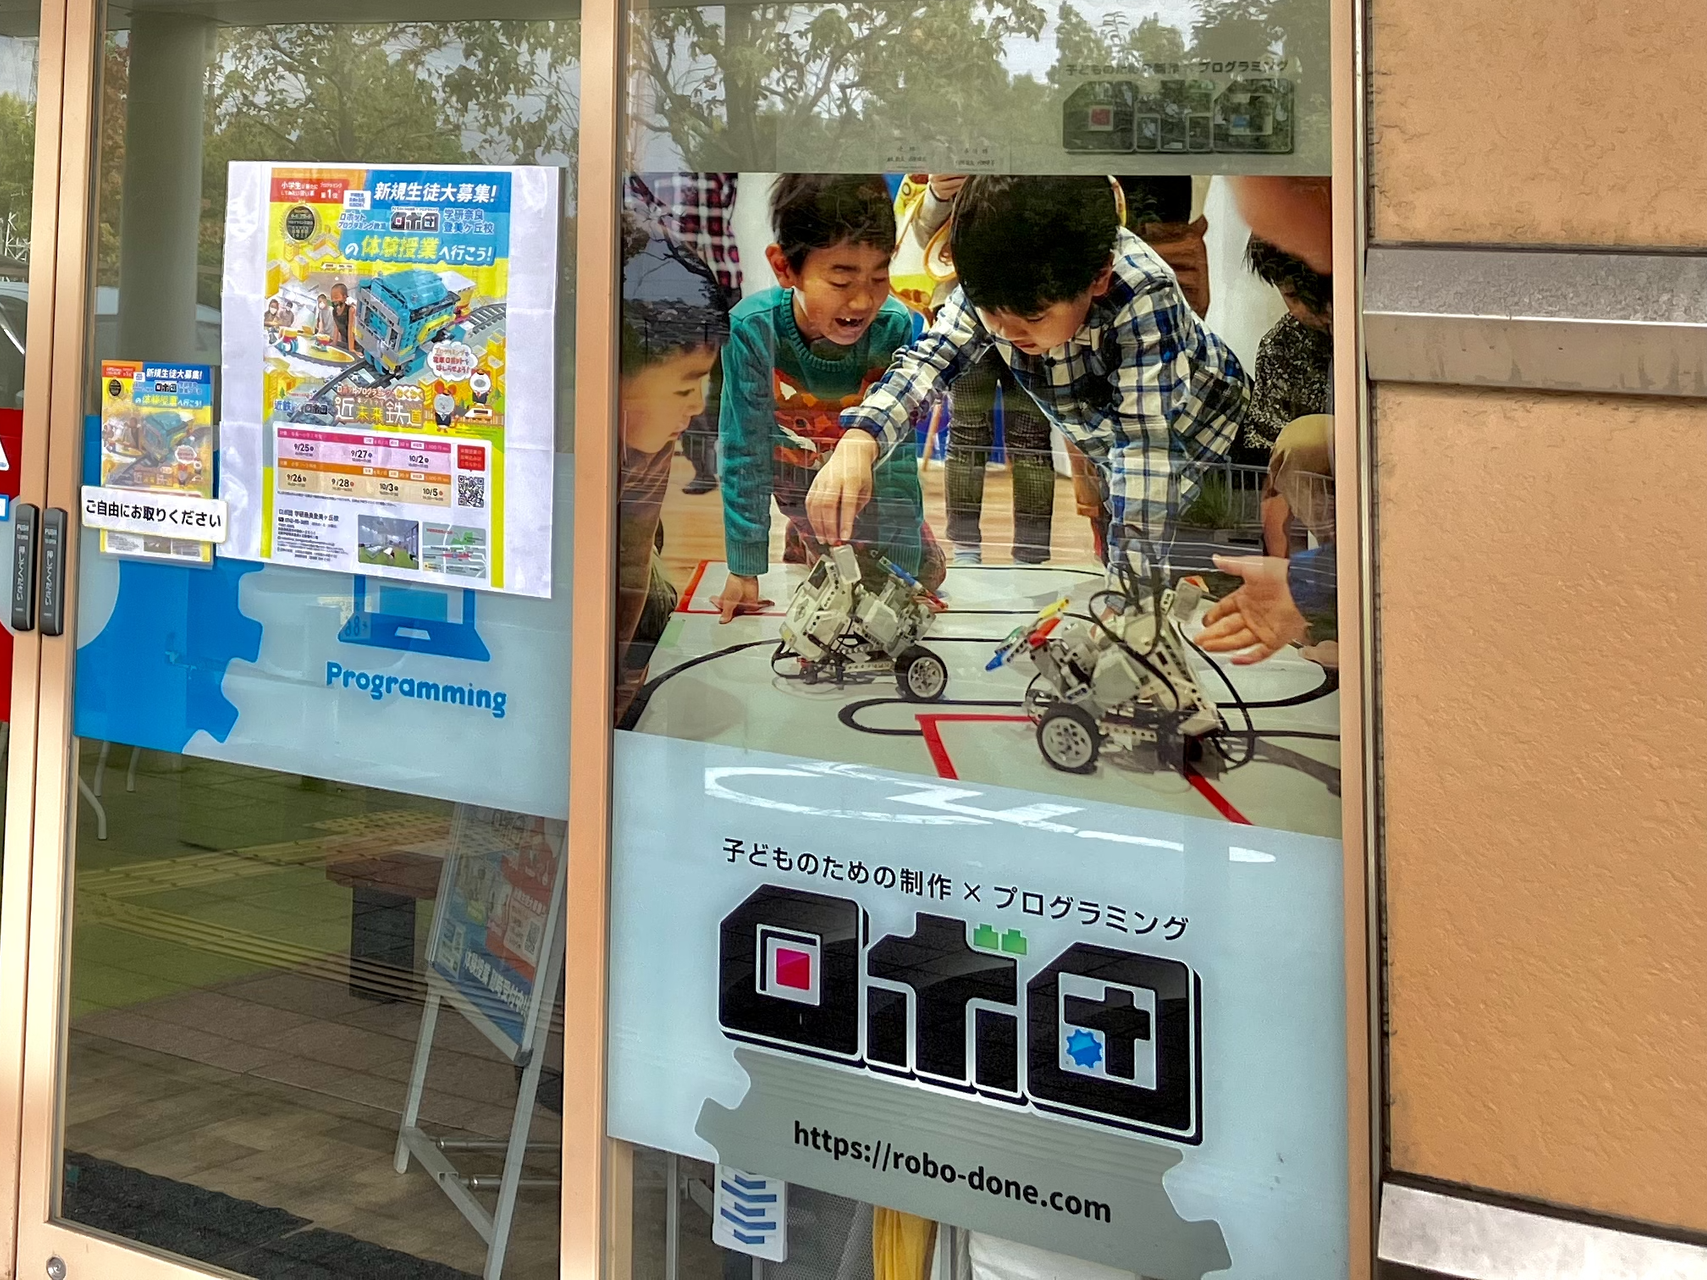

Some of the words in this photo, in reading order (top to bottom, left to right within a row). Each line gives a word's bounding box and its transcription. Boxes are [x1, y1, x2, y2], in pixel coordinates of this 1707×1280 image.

[374, 181, 497, 203] 新規生徒大募集!
[340, 212, 367, 221] ロボット
[444, 208, 484, 221] 学研奈良
[345, 235, 493, 262] の体験授業へ行こう!
[294, 443, 310, 452] 9/25
[350, 449, 368, 459] 9/27
[409, 455, 424, 463] 10/2
[287, 474, 302, 483] 9/26
[331, 478, 350, 488] 9/28
[379, 483, 394, 492] 10/3
[422, 488, 438, 497] 10/5
[85, 498, 222, 528] ご自由にお取りください
[326, 661, 507, 719] Programming
[722, 838, 952, 901] 子どものための制作
[993, 884, 1190, 943] プログラミング
[793, 1120, 1113, 1224] https://robo-done.com
